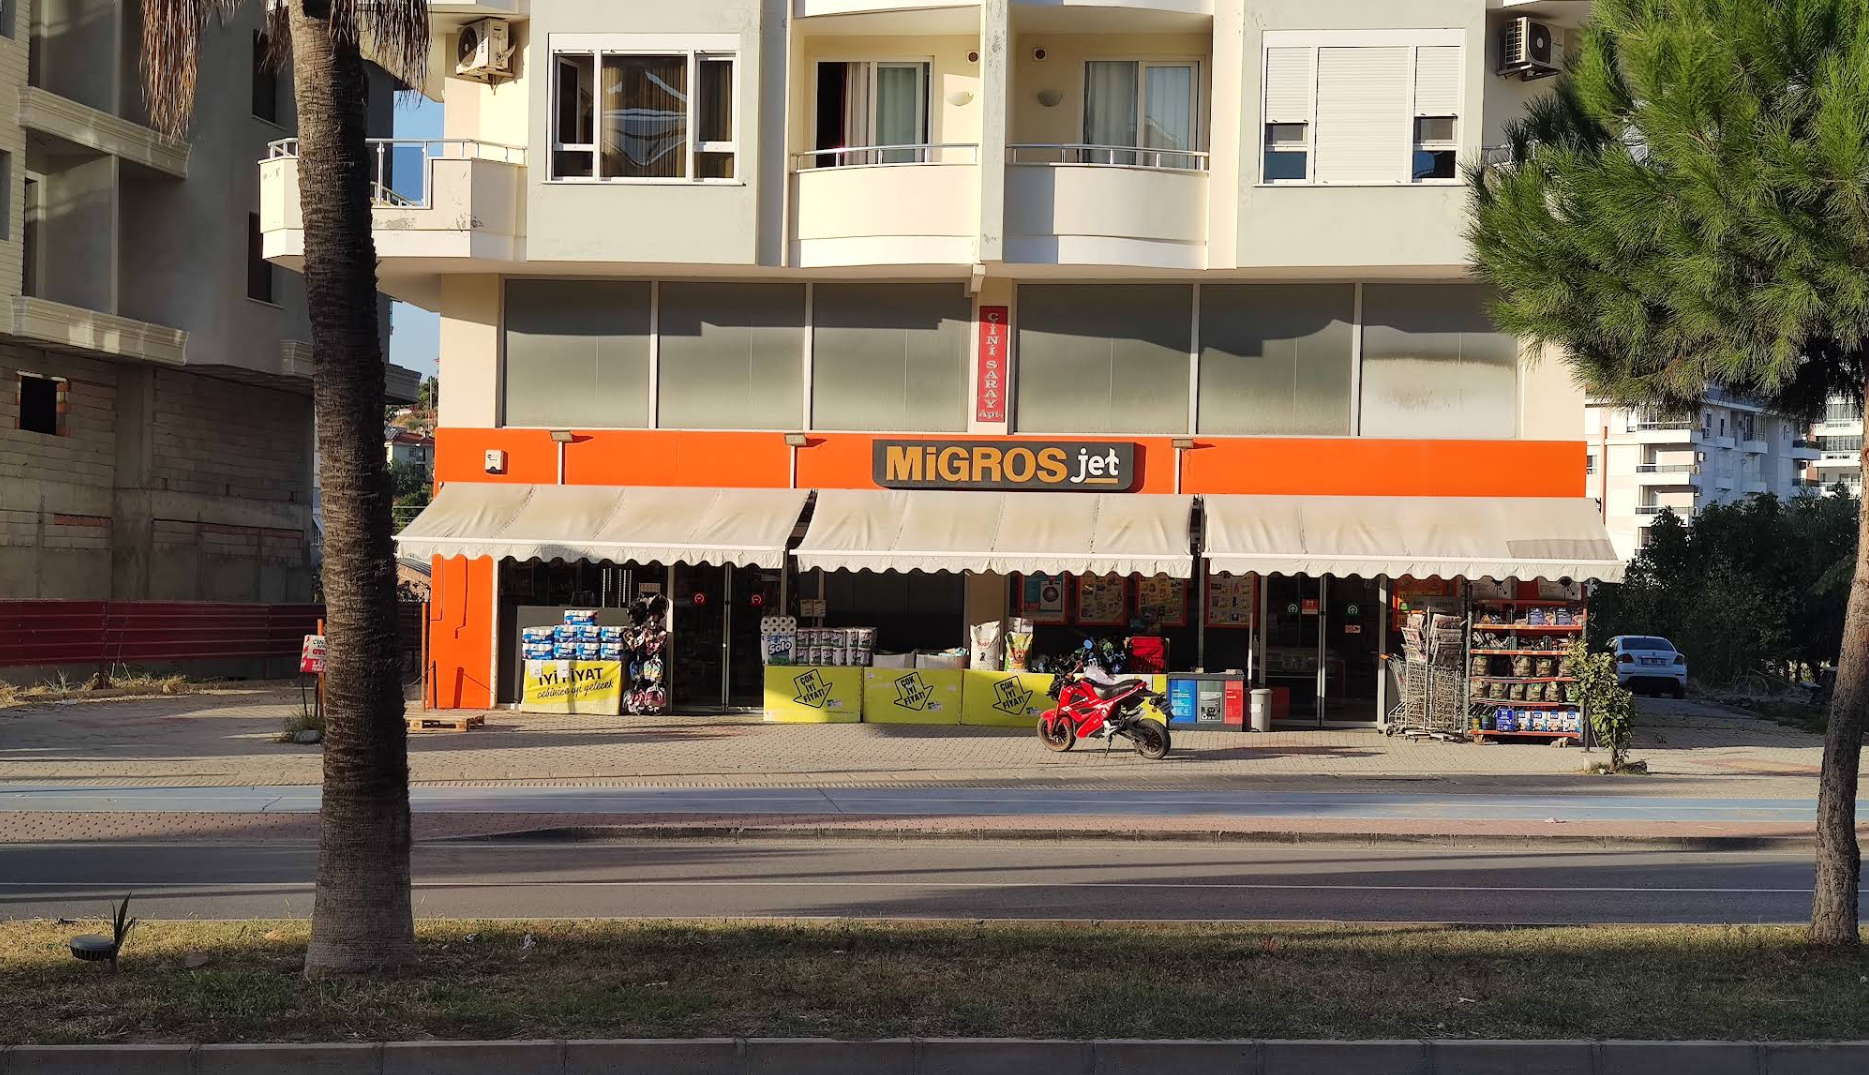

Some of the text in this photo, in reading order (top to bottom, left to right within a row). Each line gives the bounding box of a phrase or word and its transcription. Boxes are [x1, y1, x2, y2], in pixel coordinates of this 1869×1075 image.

[985, 312, 1000, 409] ÇİNİ SARAY
[1070, 448, 1120, 484] jet
[768, 641, 791, 655] Solo
[800, 674, 815, 686] ÇOK
[901, 676, 915, 688] ÇOK
[1000, 680, 1014, 691] ÇOK
[571, 684, 582, 698] iyi
[584, 678, 614, 696] gelecek
[804, 682, 816, 693] İYİ
[905, 684, 917, 696] İYİ
[1004, 688, 1016, 700] İYİ
